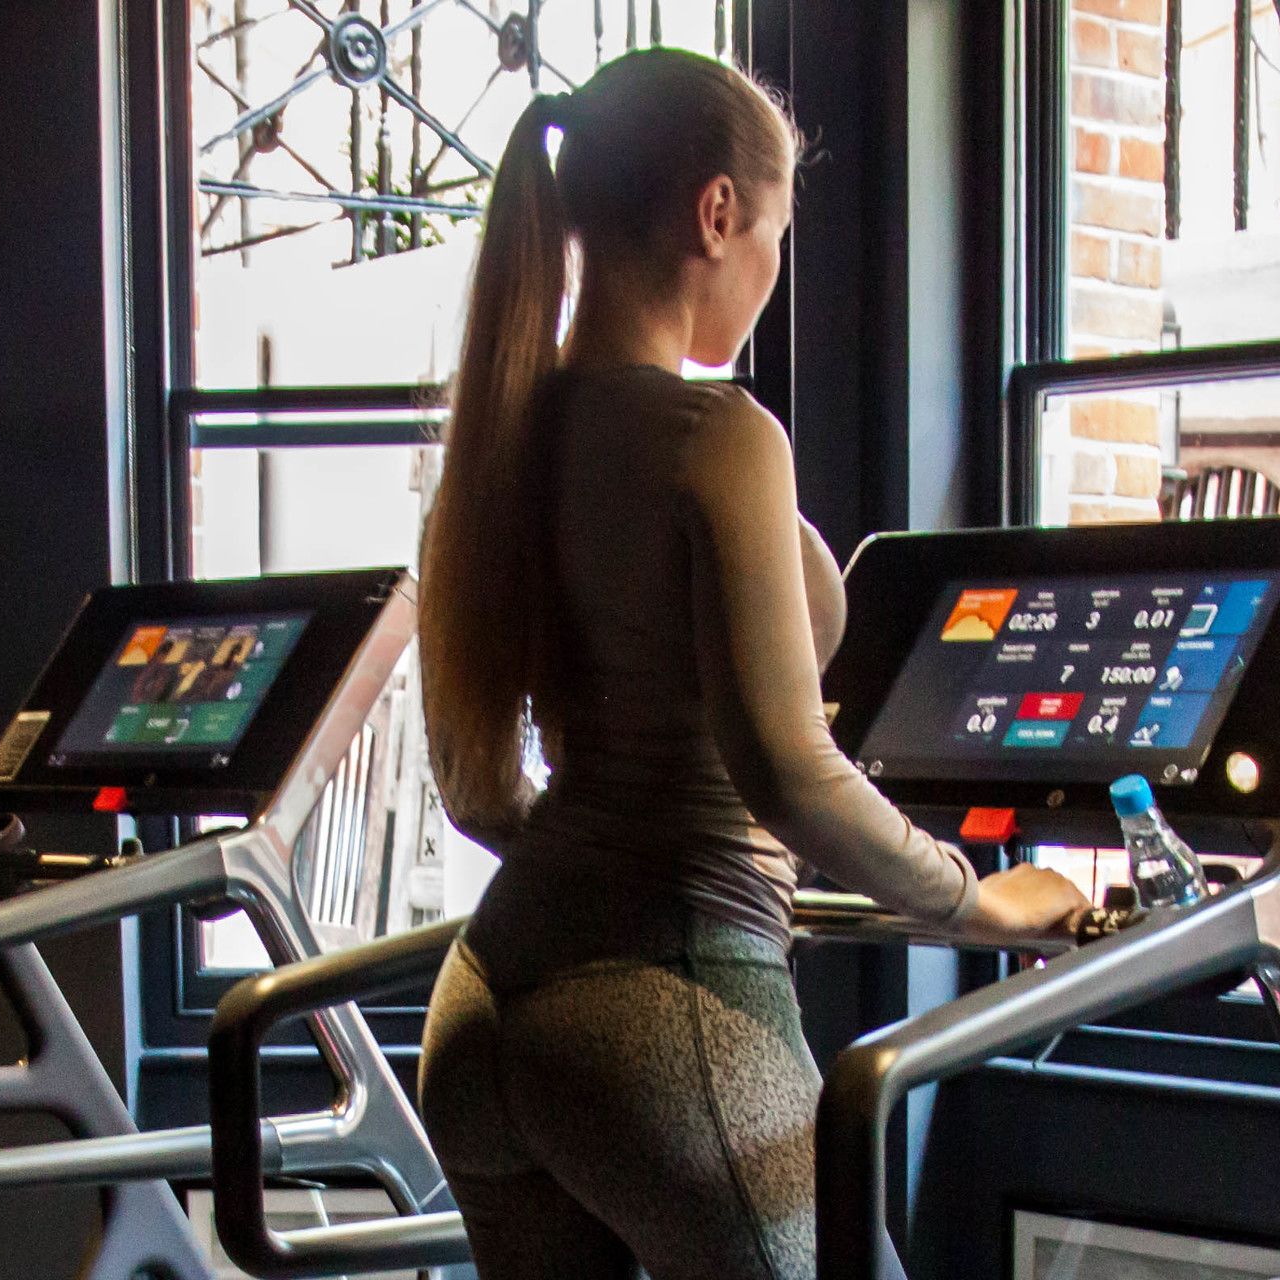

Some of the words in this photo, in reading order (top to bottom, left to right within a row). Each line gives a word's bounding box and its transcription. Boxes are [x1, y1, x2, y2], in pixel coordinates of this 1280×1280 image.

[1008, 612, 1059, 631] 02:26
[1085, 611, 1101, 630] 3
[1134, 610, 1174, 629] 0.01
[1060, 664, 1075, 684] 7
[1101, 665, 1156, 684] 150:00
[966, 714, 997, 733] 0.0
[1087, 715, 1119, 734] 0.4
